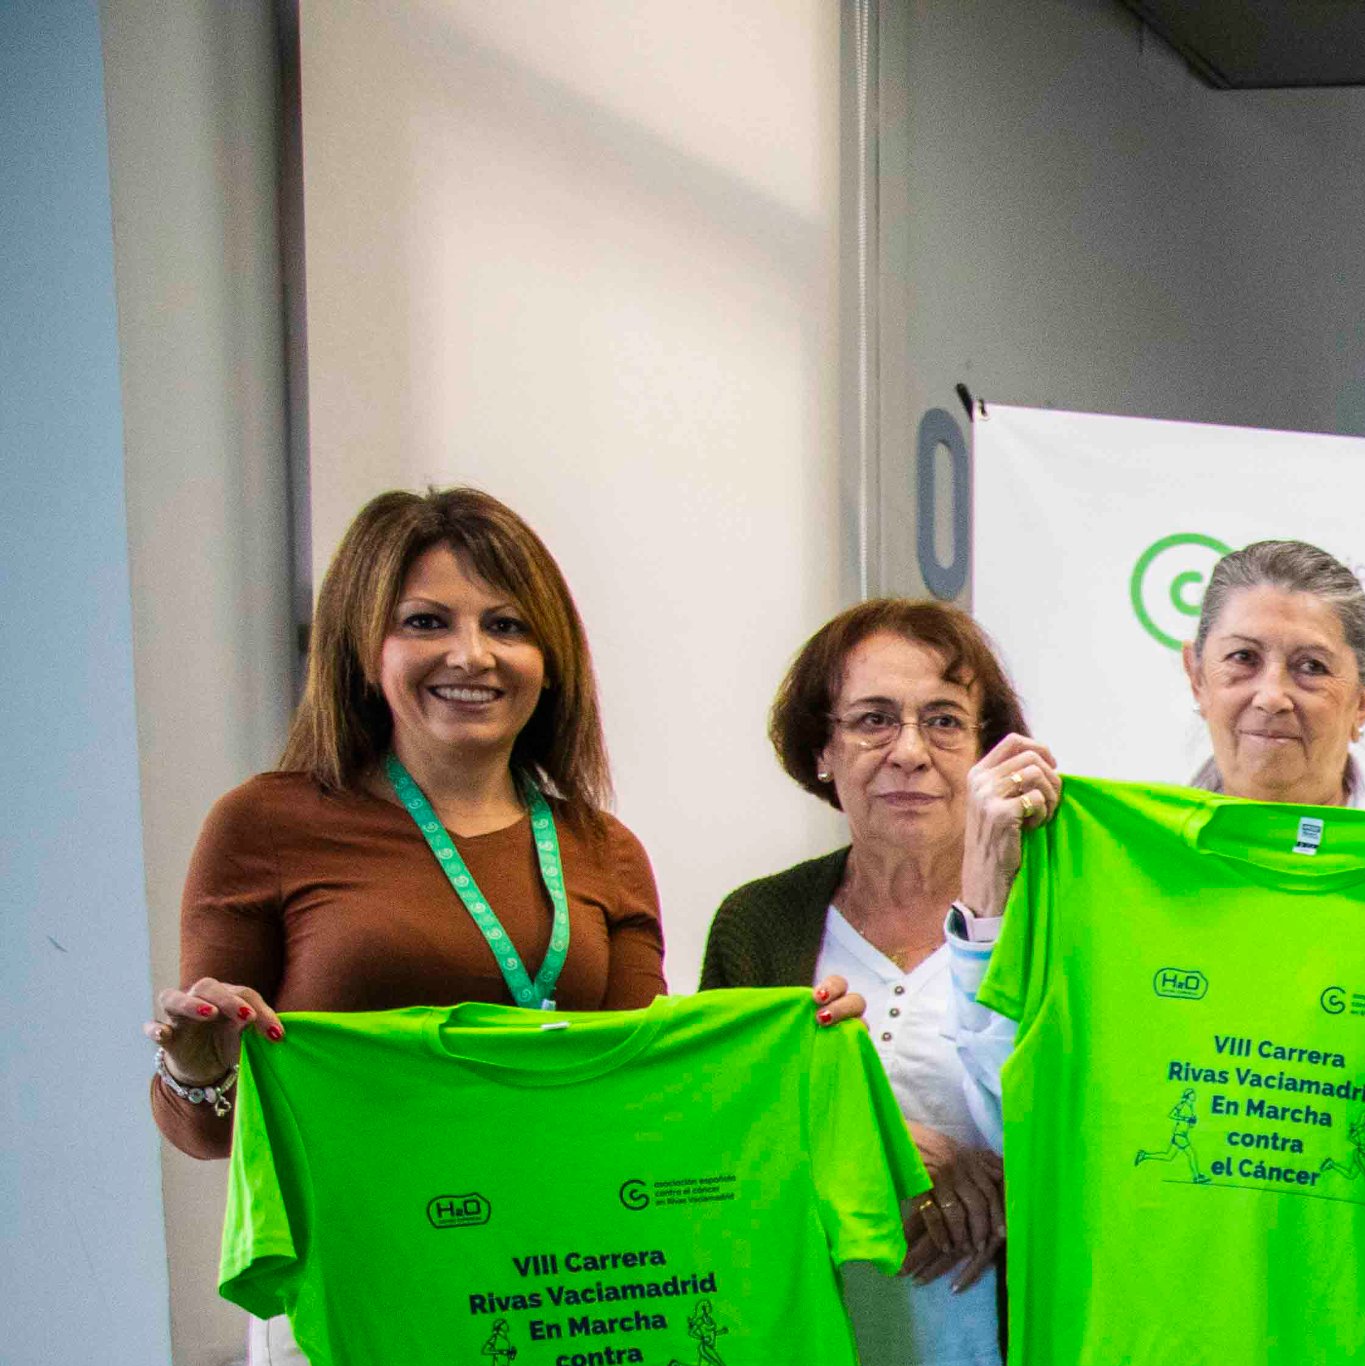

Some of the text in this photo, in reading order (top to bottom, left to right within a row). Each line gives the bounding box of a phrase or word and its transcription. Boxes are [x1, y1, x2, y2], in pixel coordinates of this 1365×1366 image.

[1214, 1035, 1346, 1068] VIII Carrera
[1168, 1062, 1229, 1084] Rivas
[1211, 1095, 1332, 1127] En Marcha
[1227, 1131, 1304, 1153] contra
[1211, 1157, 1321, 1186] el Cáncer
[512, 1250, 666, 1278] VIII Carrera
[469, 1272, 717, 1315] Rivas Vaciamadrid
[529, 1311, 668, 1341] En Marcha
